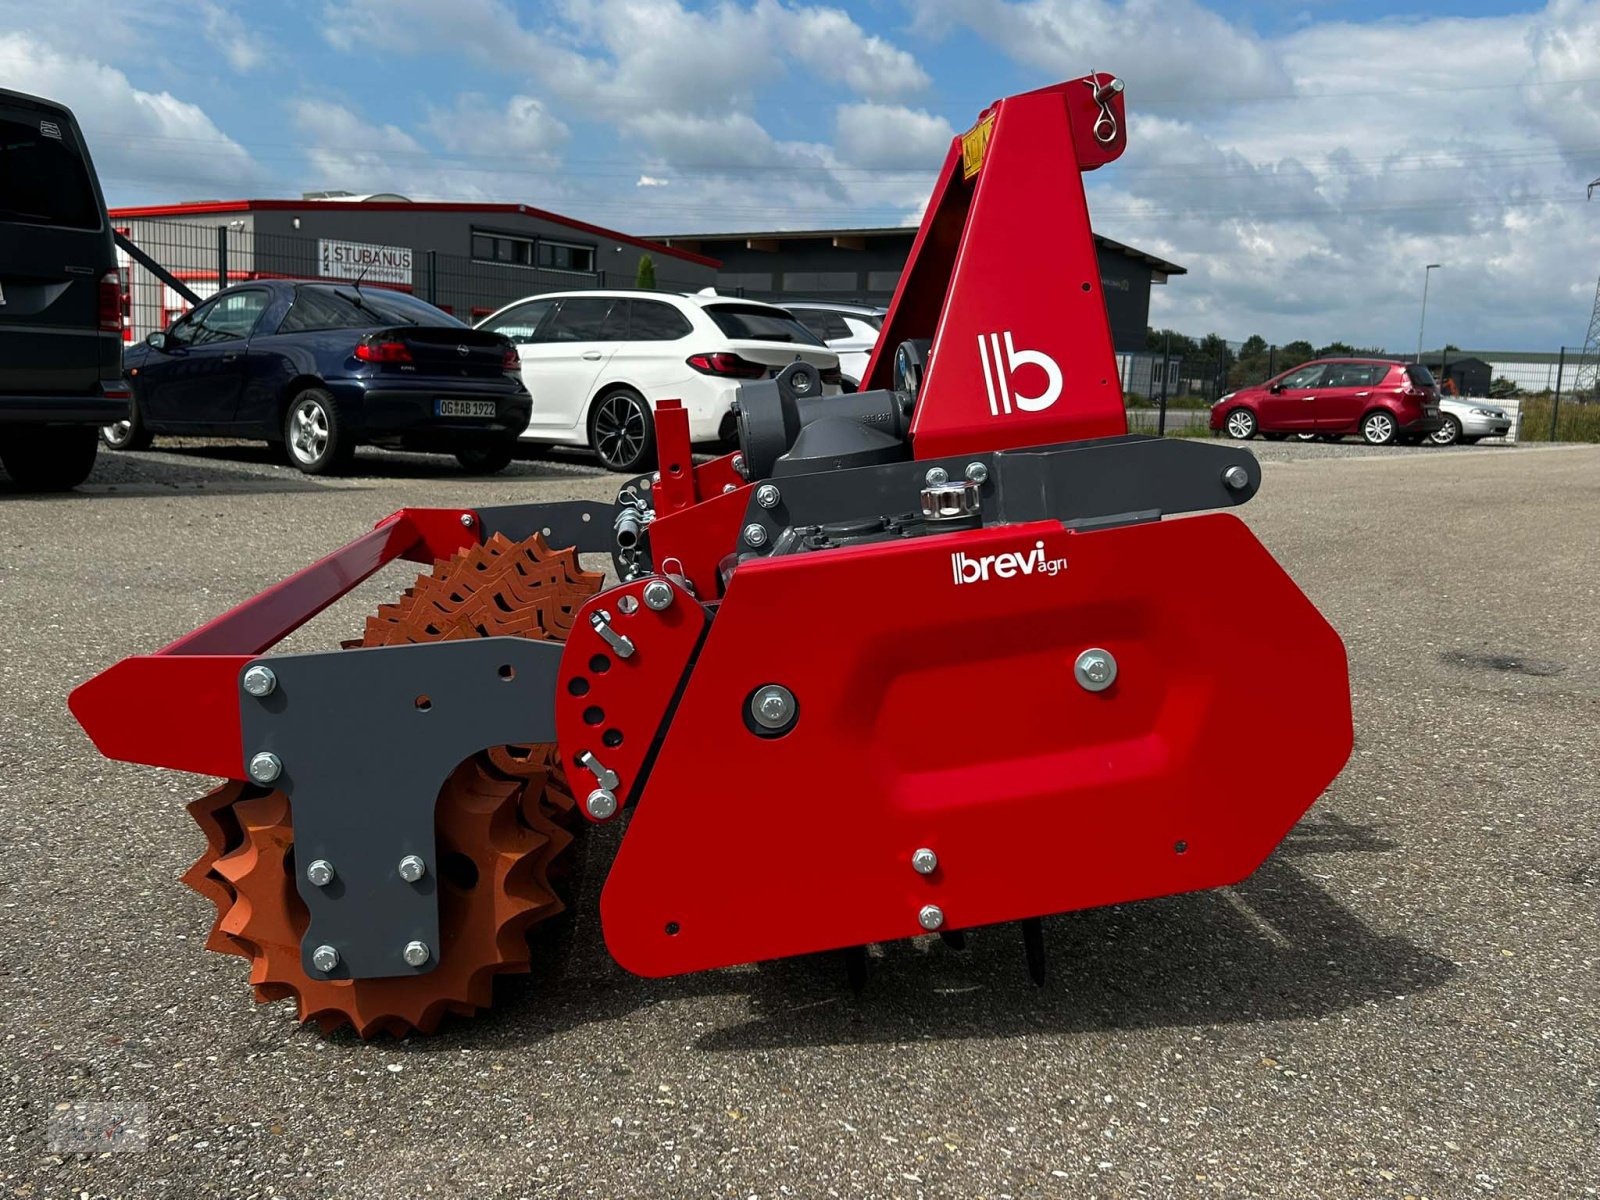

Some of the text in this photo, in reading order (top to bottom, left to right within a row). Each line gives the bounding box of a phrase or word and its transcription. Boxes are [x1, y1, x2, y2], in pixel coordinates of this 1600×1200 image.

[334, 246, 411, 269] STUBANUS
[460, 402, 471, 415] AB
[473, 402, 495, 416] 1922
[951, 540, 1068, 585] brevi agri
